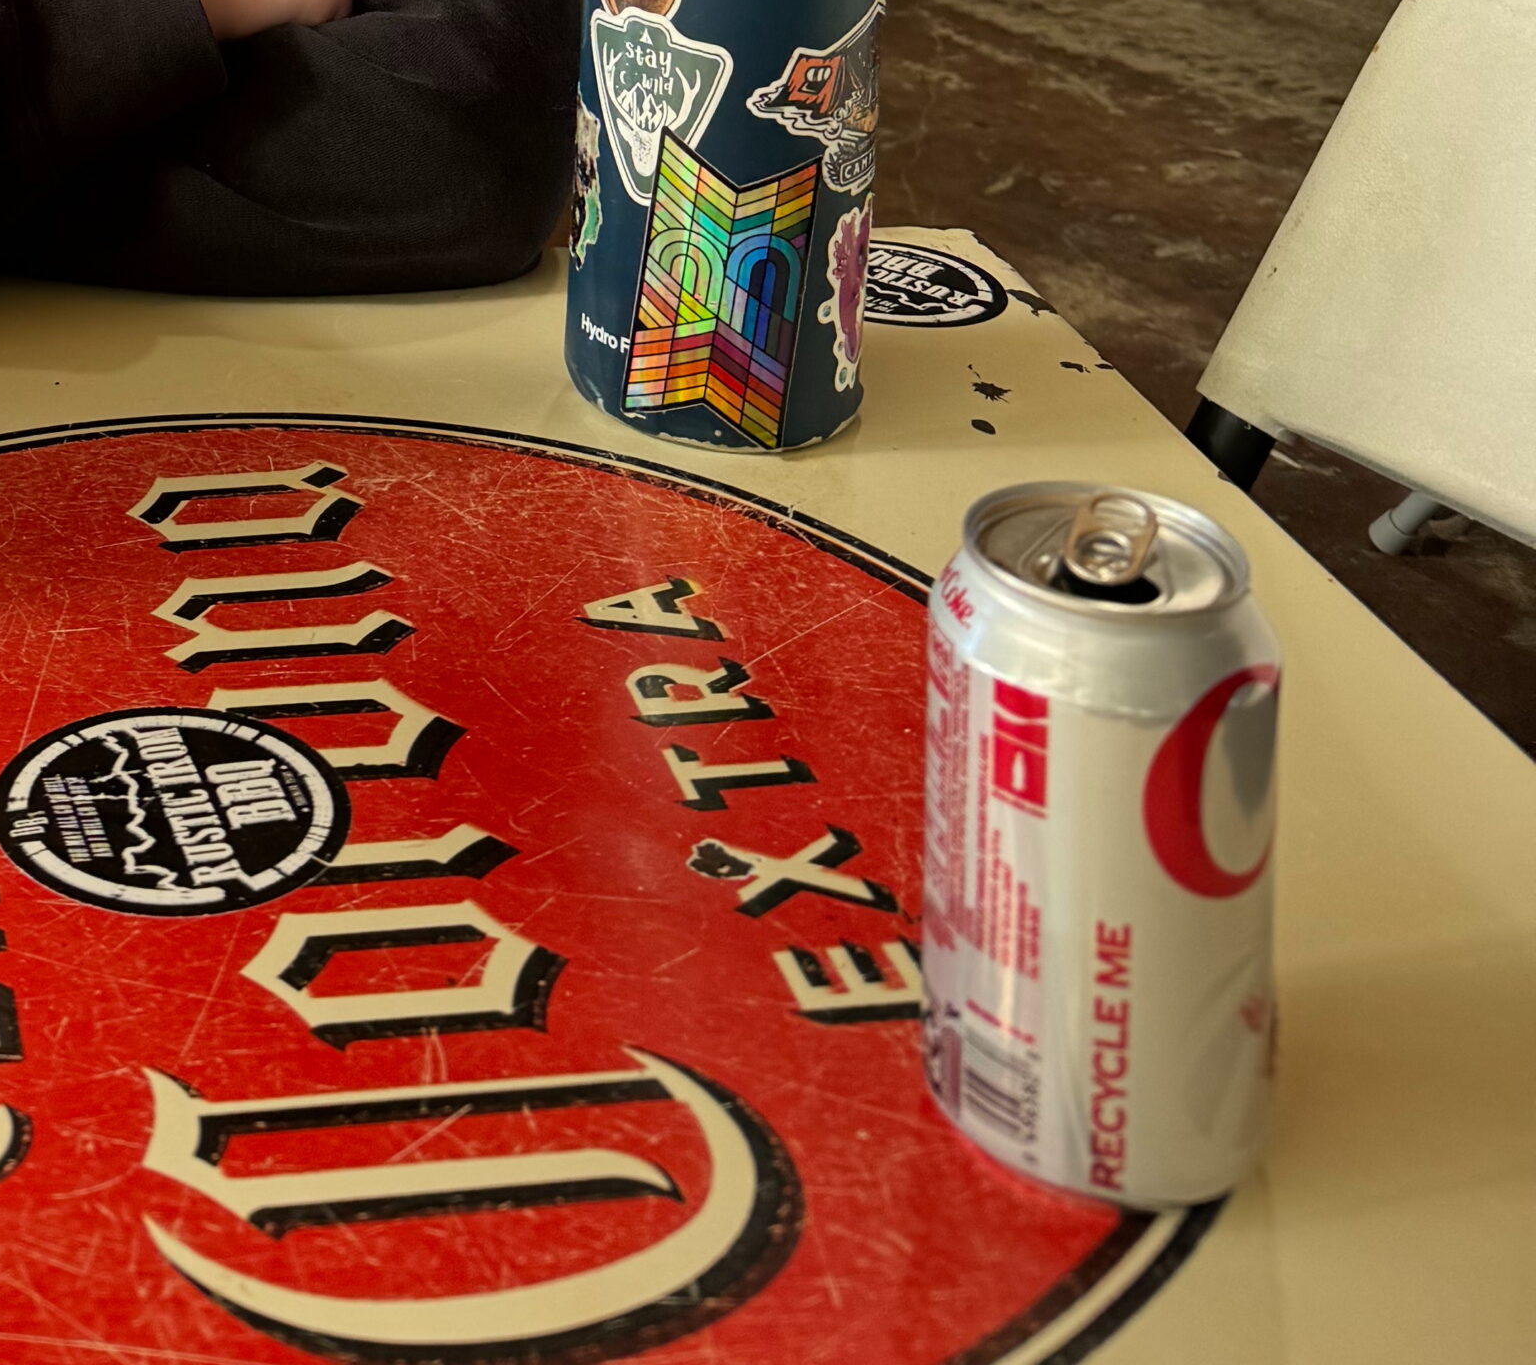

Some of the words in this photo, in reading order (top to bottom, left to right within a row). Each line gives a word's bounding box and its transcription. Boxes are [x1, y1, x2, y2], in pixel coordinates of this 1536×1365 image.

[624, 40, 672, 78] stay
[642, 73, 674, 96] wild
[866, 267, 972, 307] RUSTIC
[581, 312, 618, 349] Hydro
[135, 726, 202, 788] IRON
[205, 758, 297, 830] BBQ
[579, 573, 924, 1025] EXTRA
[160, 787, 241, 885] RUSTIC
[126, 456, 807, 1359] Corona
[1094, 919, 1132, 990] ME
[1088, 996, 1131, 1192] RECYCLE
